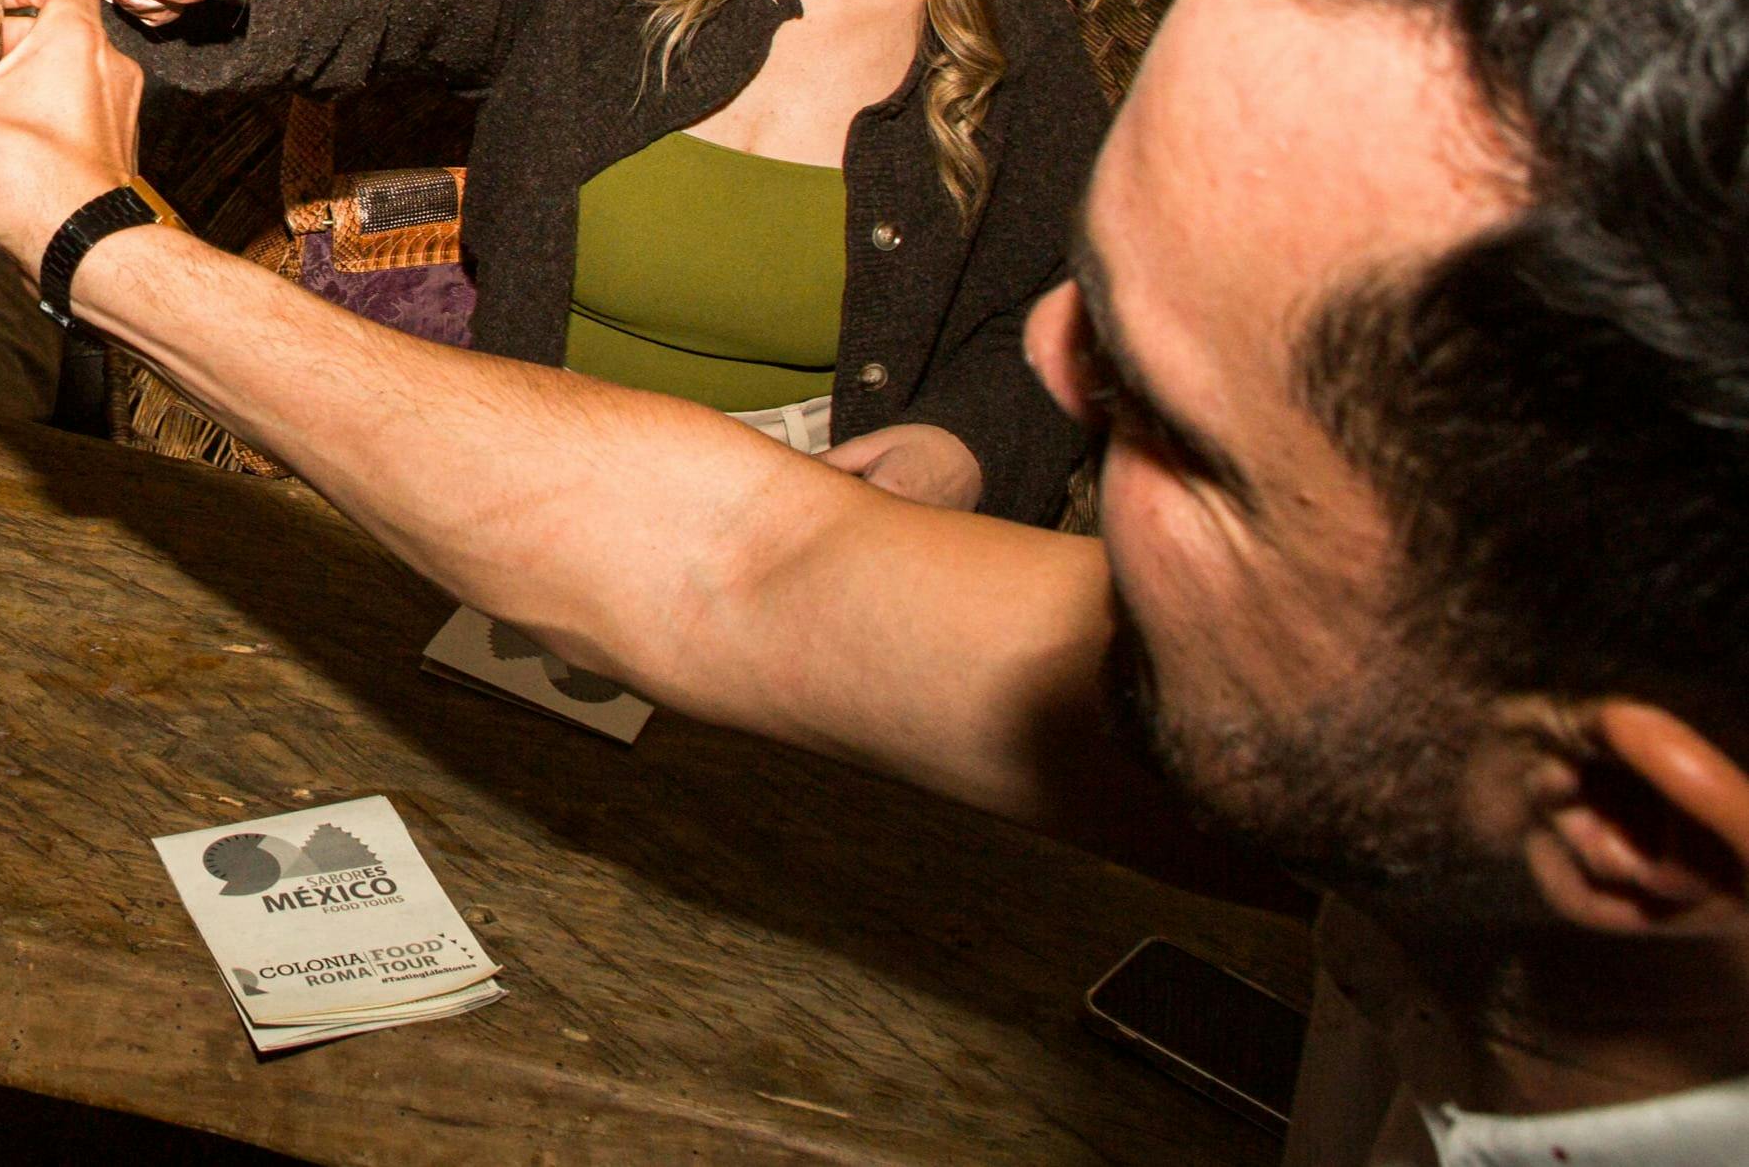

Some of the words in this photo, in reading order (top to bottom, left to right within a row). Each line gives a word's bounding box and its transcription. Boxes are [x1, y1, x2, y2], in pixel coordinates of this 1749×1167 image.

[306, 865, 388, 887] SABORES
[261, 877, 398, 913] MÉXICO
[322, 902, 361, 914] FOOD
[362, 895, 405, 909] TOURS
[258, 952, 366, 979] COLONIA
[369, 939, 444, 962] FOOD
[304, 966, 373, 987] ROMA
[377, 955, 440, 975] TOUR
